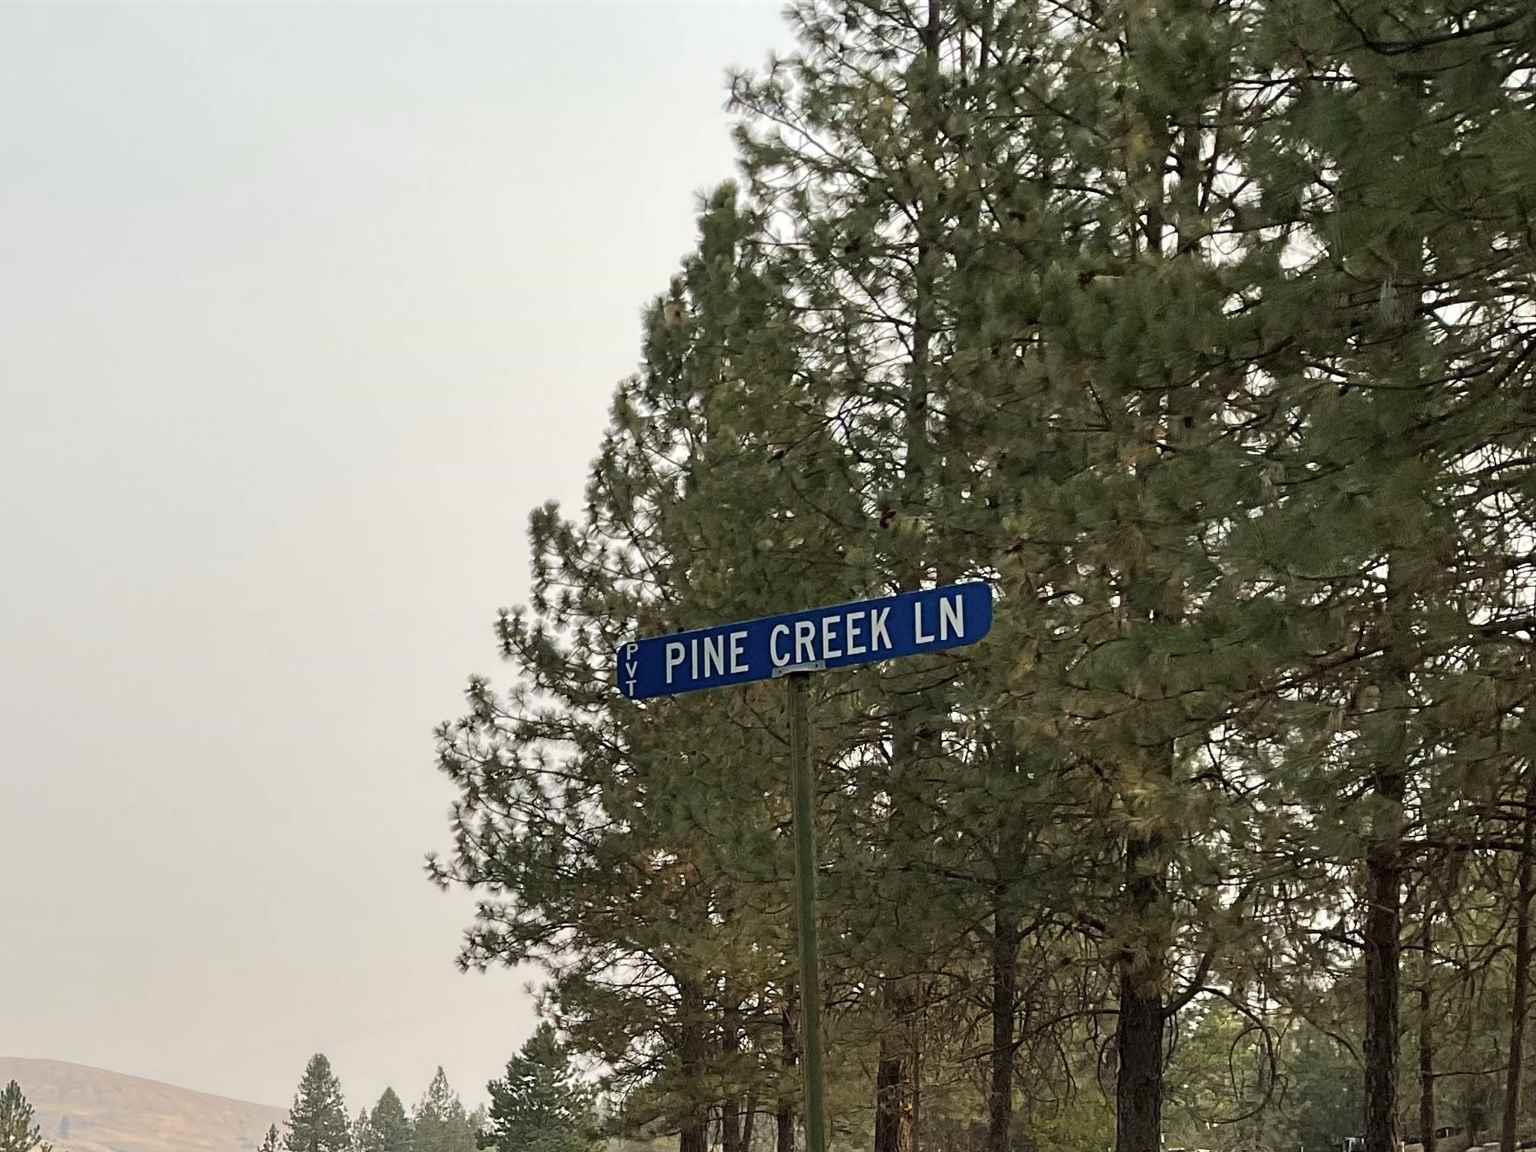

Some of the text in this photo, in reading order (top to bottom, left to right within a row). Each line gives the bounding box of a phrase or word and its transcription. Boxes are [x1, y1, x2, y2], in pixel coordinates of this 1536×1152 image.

[626, 643, 639, 697] PVT
[666, 594, 965, 683] PINE CREEK LN
